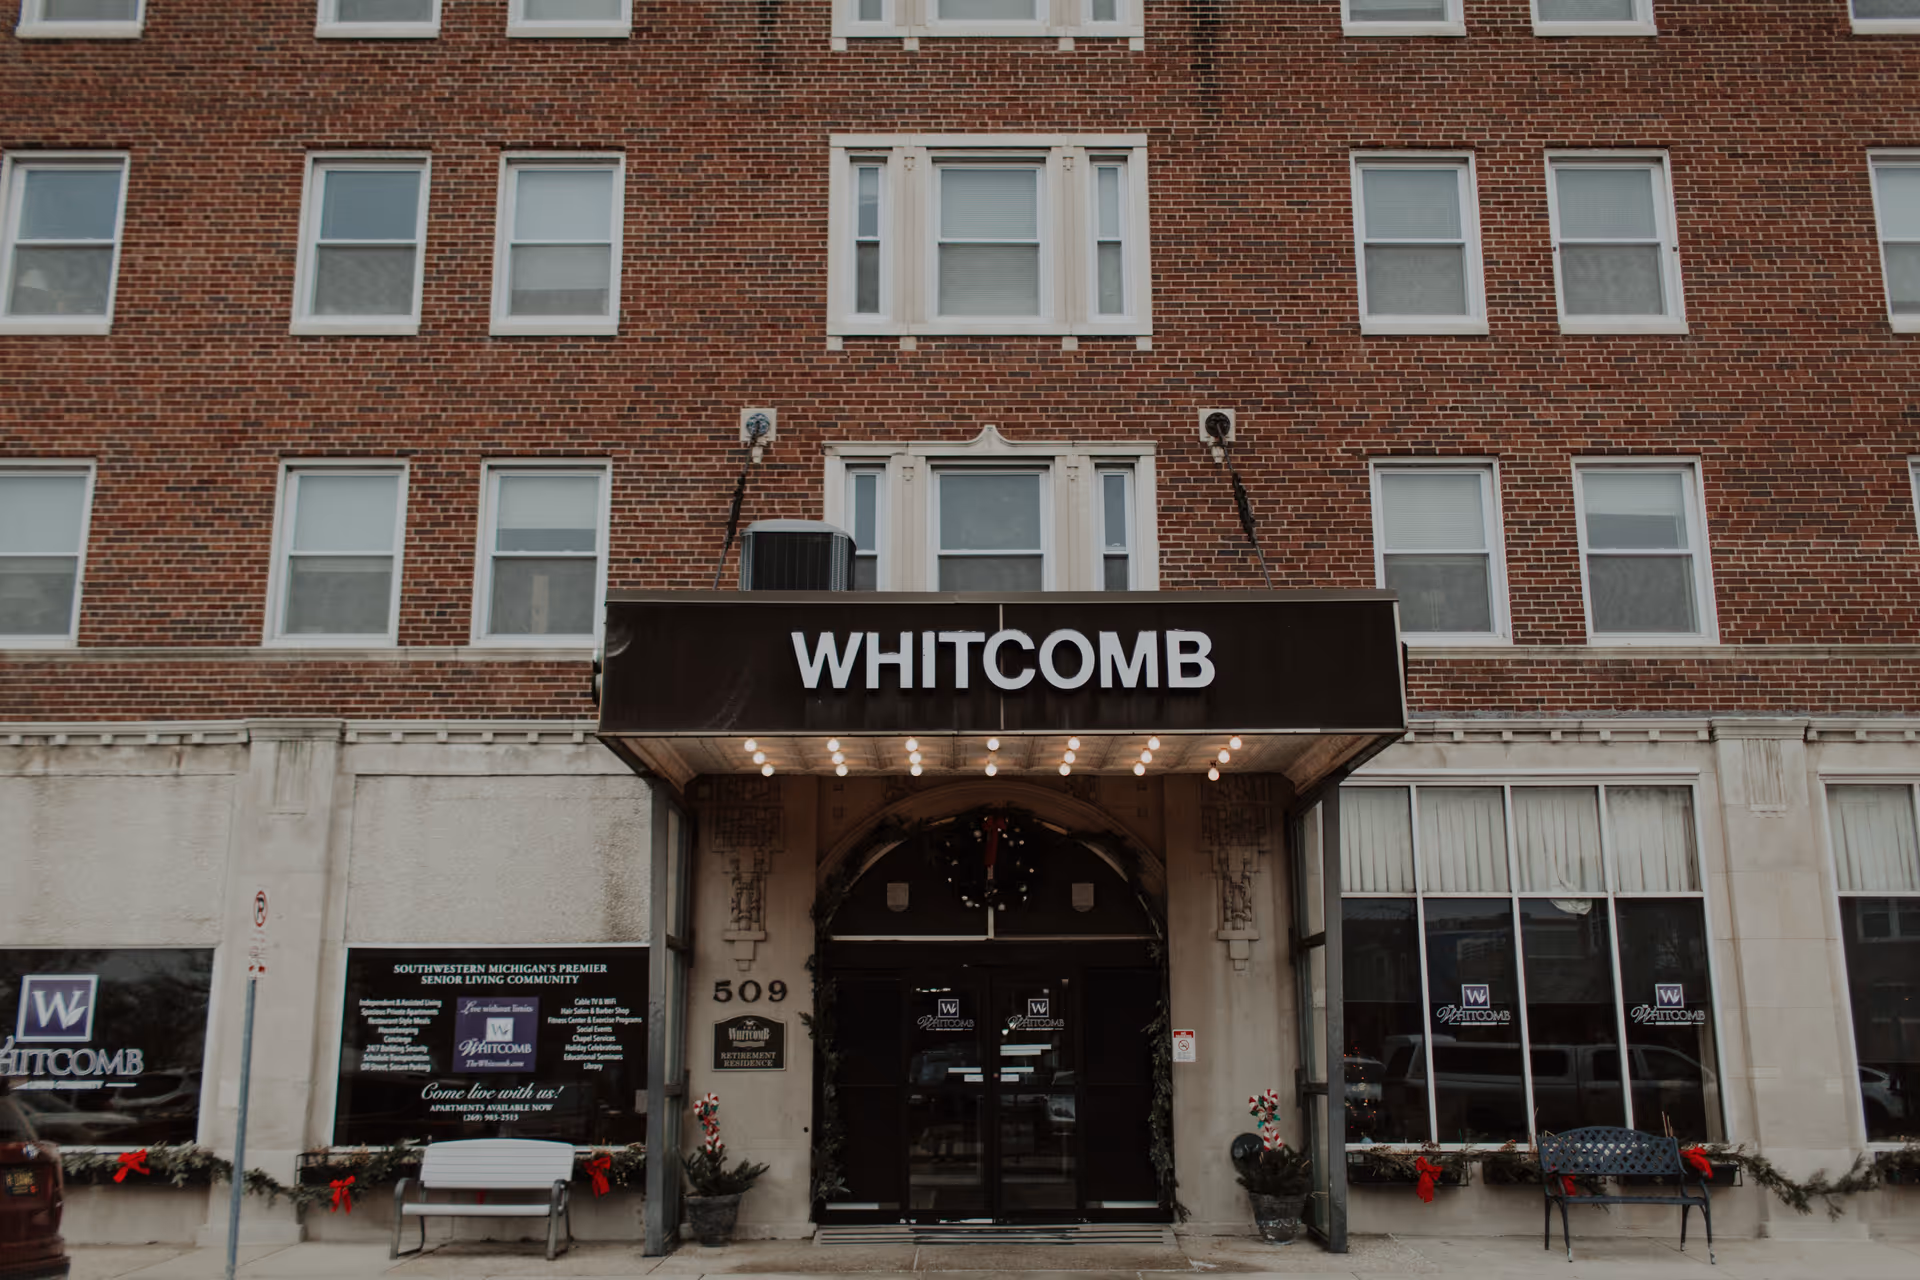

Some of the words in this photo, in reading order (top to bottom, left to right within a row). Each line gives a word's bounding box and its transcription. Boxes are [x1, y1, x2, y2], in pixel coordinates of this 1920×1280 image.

[791, 628, 1216, 690] WHITCOMB
[393, 964, 486, 974] SOUTHWESTERN
[488, 964, 556, 974] MICHIGAN'S
[558, 964, 608, 973] PREMIER
[420, 975, 463, 985] SENIOR
[465, 975, 505, 985] LIVING
[507, 975, 580, 985] COMMUNITY
[713, 979, 788, 1003] 509
[32, 990, 88, 1029] W
[406, 1008, 439, 1016] Apartments
[560, 1007, 573, 1015] Hair
[615, 1007, 630, 1015] Shop
[1436, 1006, 1511, 1023] WHITCOMB
[1630, 1005, 1706, 1023] WHITCOMB
[615, 1016, 642, 1025] Programs
[917, 1015, 975, 1029] WHITCOMB
[1007, 1015, 1065, 1029] WHITCOMB
[572, 1034, 592, 1043] Chapel
[593, 1034, 616, 1042] Services
[728, 1027, 771, 1040] WHITCOMB
[384, 1036, 412, 1044] Concierge
[458, 1038, 533, 1056] WHITCOMB
[564, 1044, 586, 1052] Holiday
[0, 1035, 145, 1076] HITCOMB
[720, 1051, 777, 1060] RETIREMENT
[583, 1062, 604, 1071] Library
[421, 1082, 465, 1100] Come
[467, 1082, 496, 1099] live
[497, 1082, 535, 1099] with
[536, 1085, 565, 1099] us!
[429, 1104, 485, 1112] APARTMENTS
[486, 1104, 530, 1112] AVAILABLE
[532, 1104, 554, 1112] NOW
[463, 1113, 482, 1121] (269)
